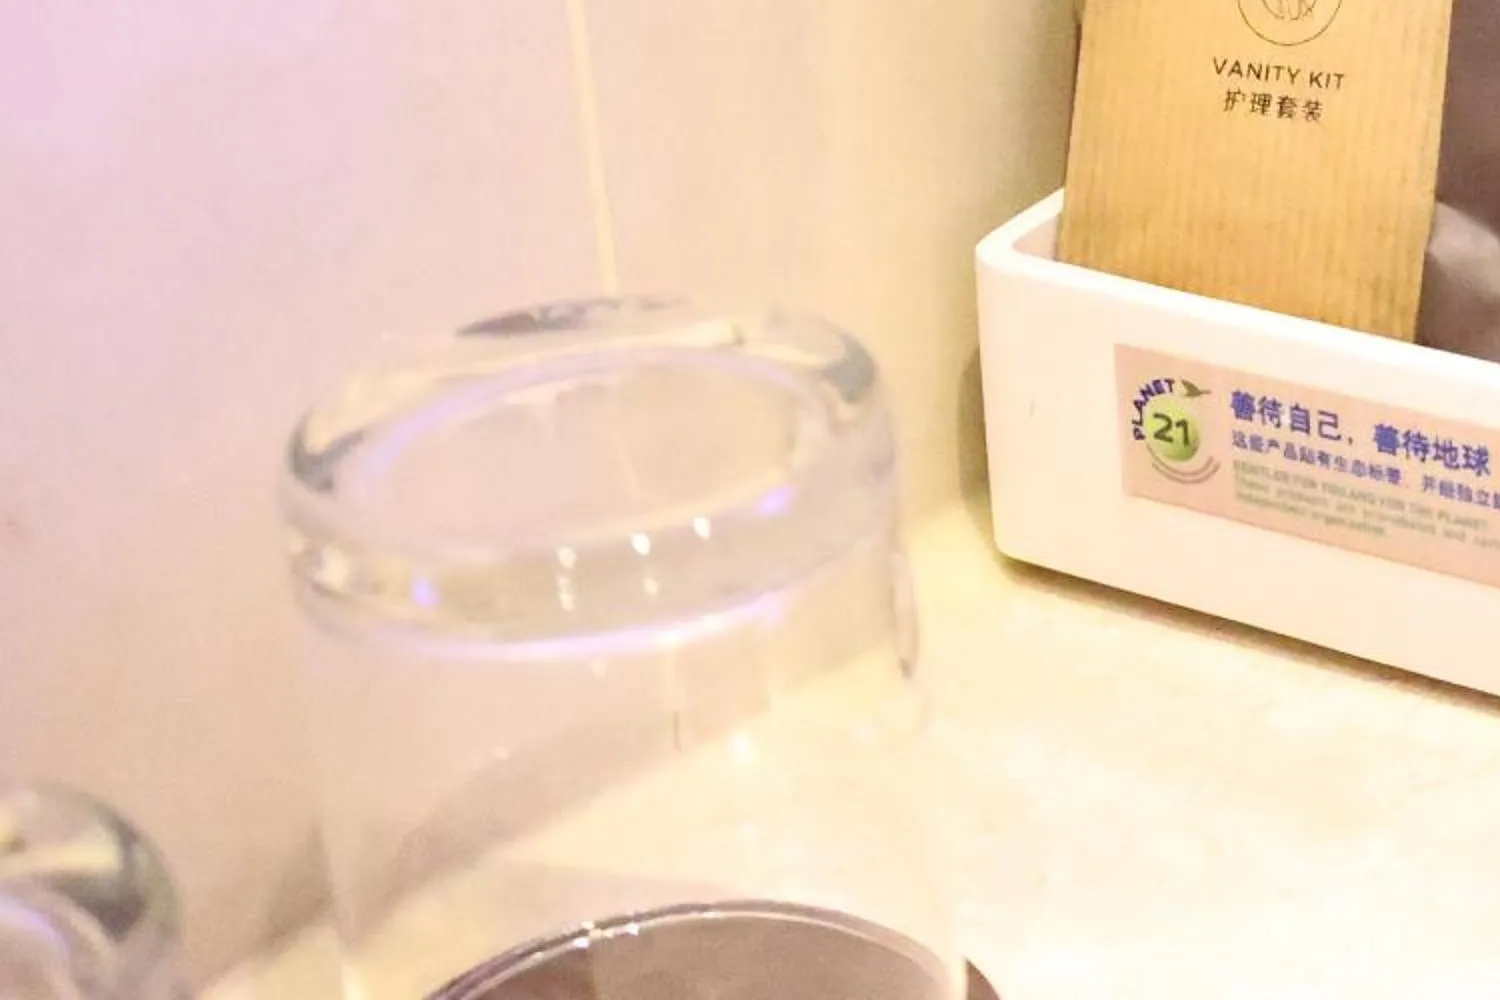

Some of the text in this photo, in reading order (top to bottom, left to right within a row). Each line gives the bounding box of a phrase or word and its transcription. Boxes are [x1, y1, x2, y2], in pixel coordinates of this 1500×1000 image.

[1212, 55, 1346, 91] VANITY KIT
[1222, 86, 1324, 123] 护理套装
[1131, 377, 1177, 441] PLANET
[1152, 411, 1191, 447] 21
